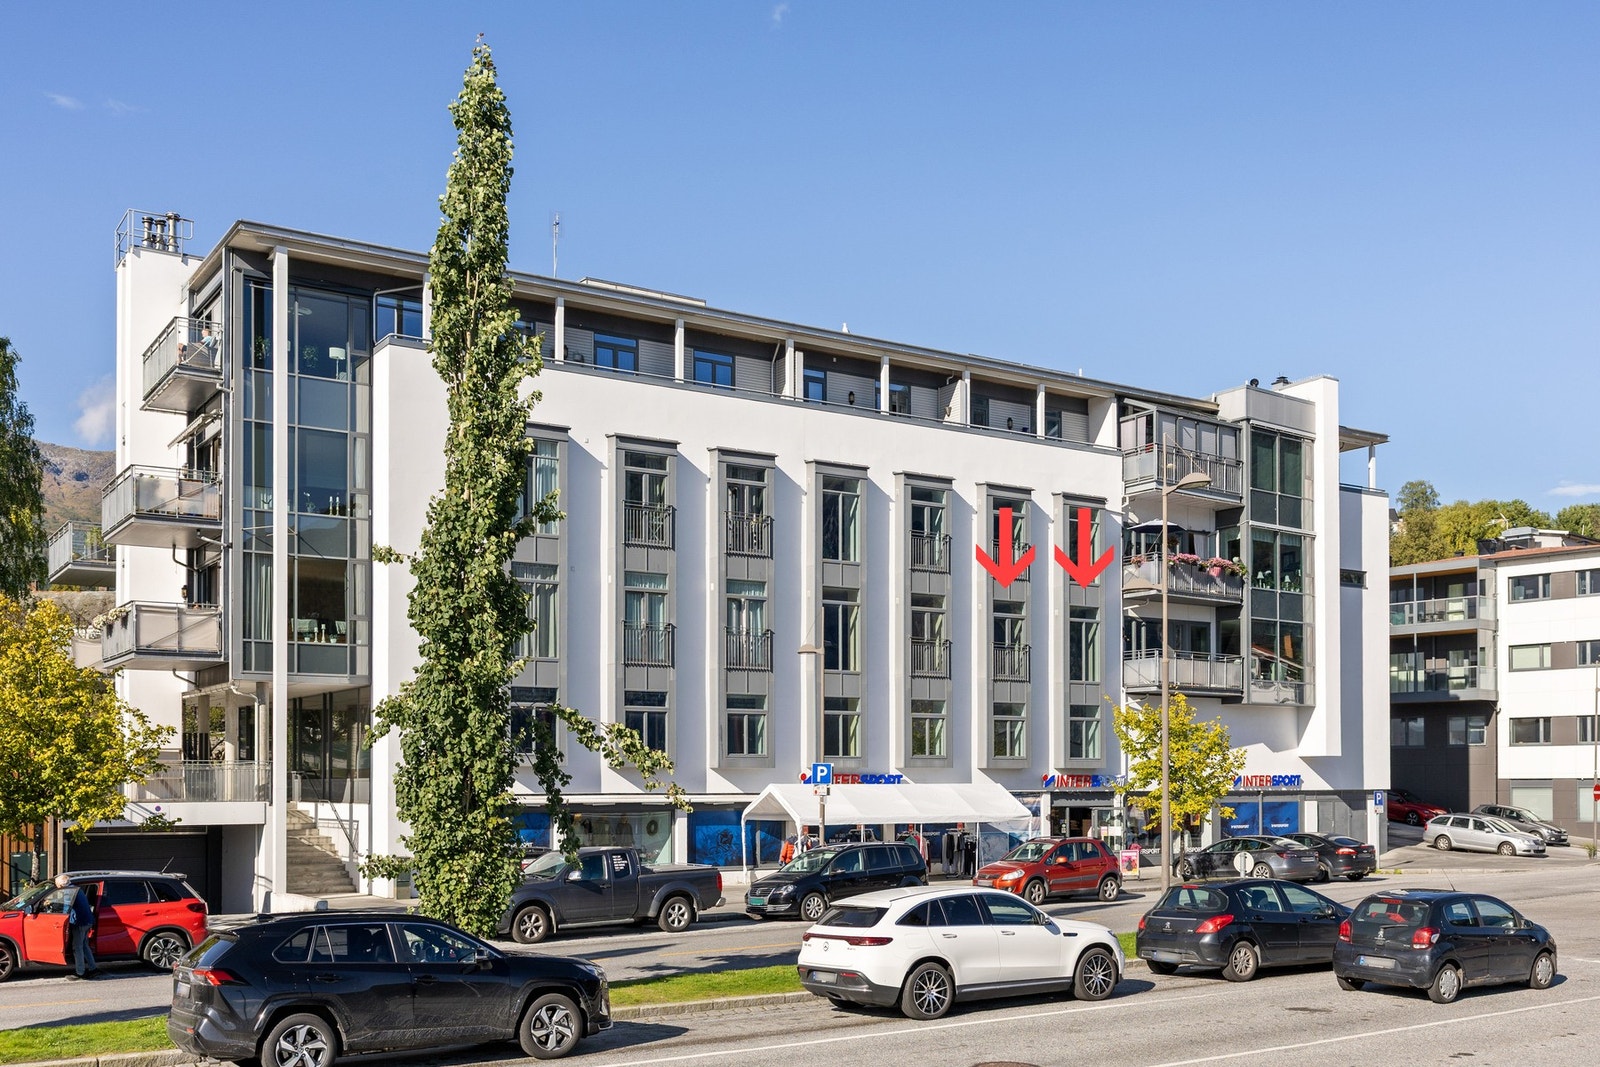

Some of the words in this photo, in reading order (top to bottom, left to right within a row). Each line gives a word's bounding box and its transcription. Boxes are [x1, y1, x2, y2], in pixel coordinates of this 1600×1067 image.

[817, 766, 828, 782] P
[833, 773, 903, 784] TERSPORT
[1242, 775, 1301, 787] INTERSPORT
[1376, 793, 1382, 804] P
